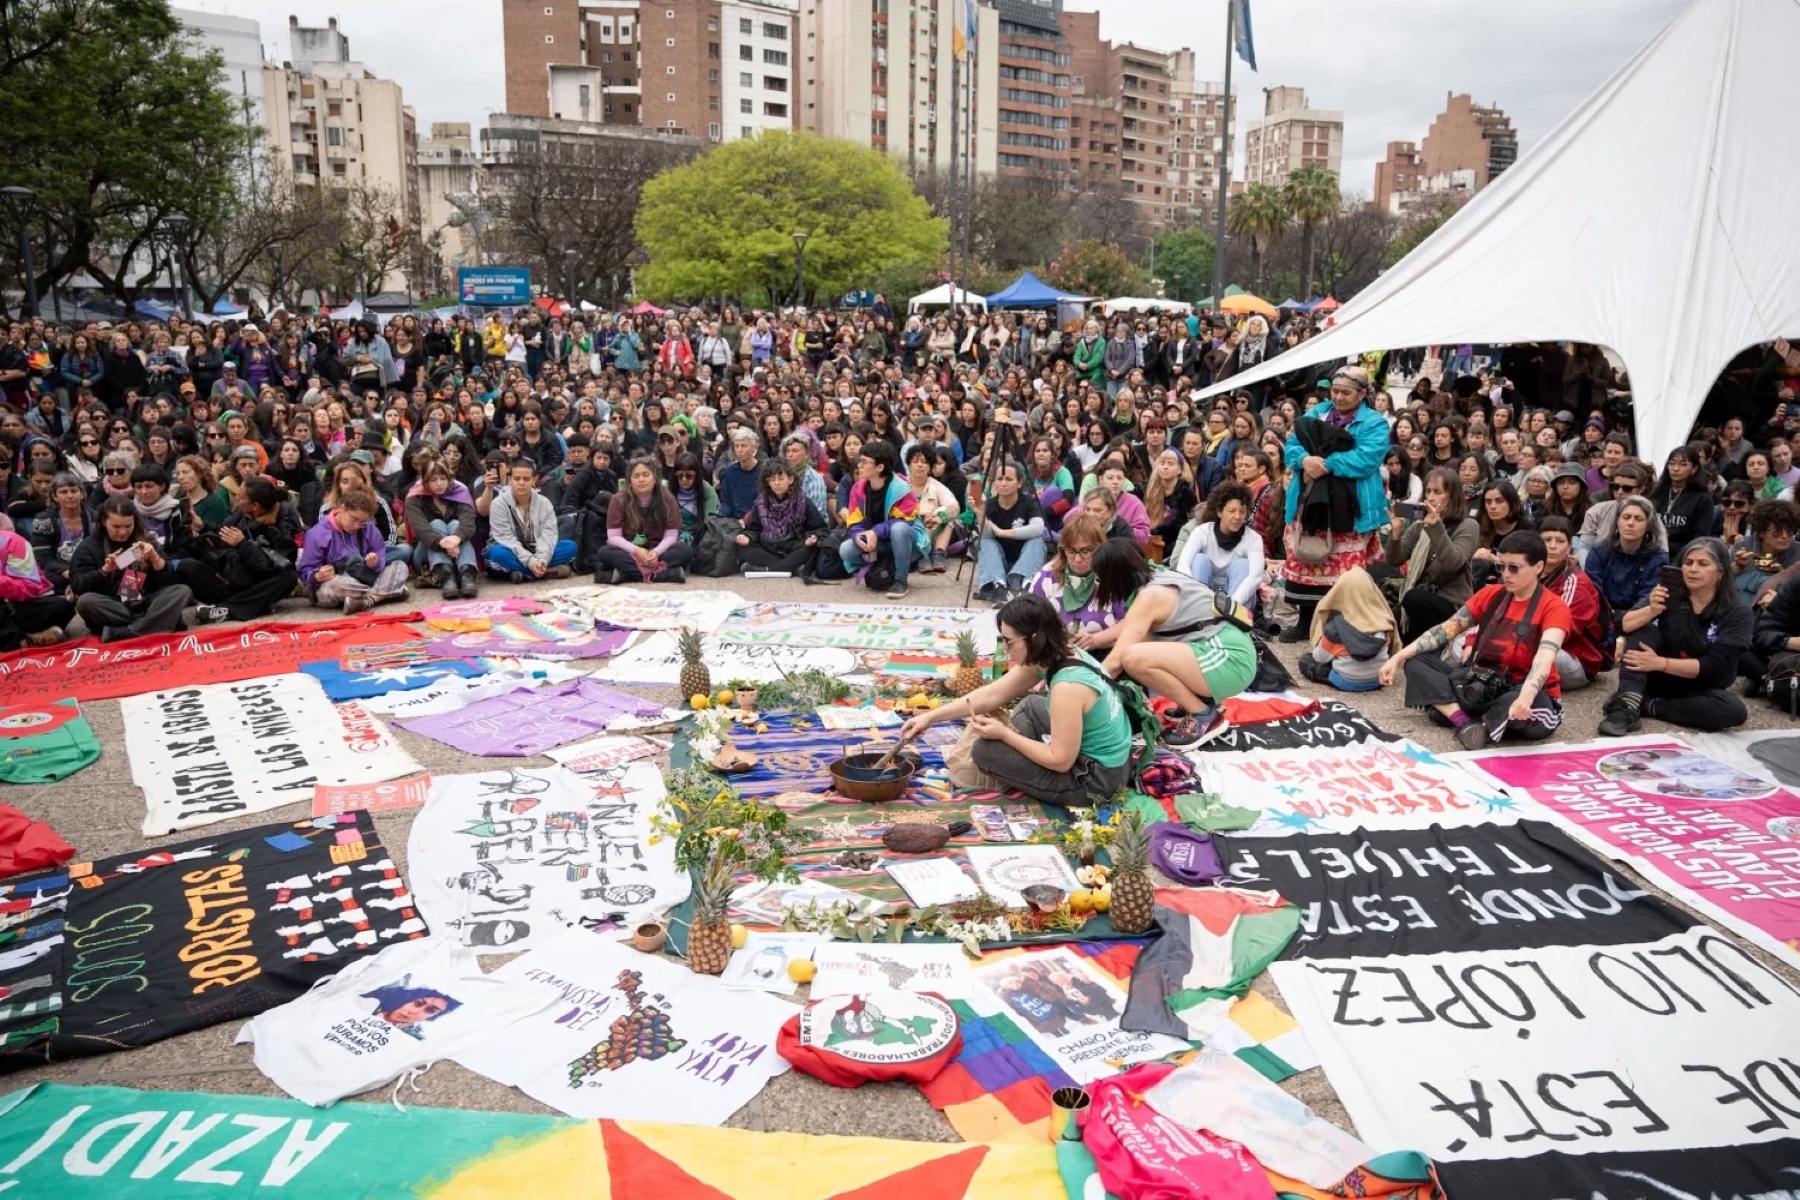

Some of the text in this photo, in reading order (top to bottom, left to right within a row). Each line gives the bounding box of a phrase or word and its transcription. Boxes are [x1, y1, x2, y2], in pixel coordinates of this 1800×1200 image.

[64, 904, 154, 1002] SOMOS
[1307, 961, 1584, 1039] LÓPEZ
[332, 1024, 378, 1053] JURAMOS
[345, 1018, 368, 1034] POR
[702, 1032, 768, 1065] ABYA
[676, 1049, 739, 1086] YALA
[1420, 1070, 1668, 1153] ESTÁ
